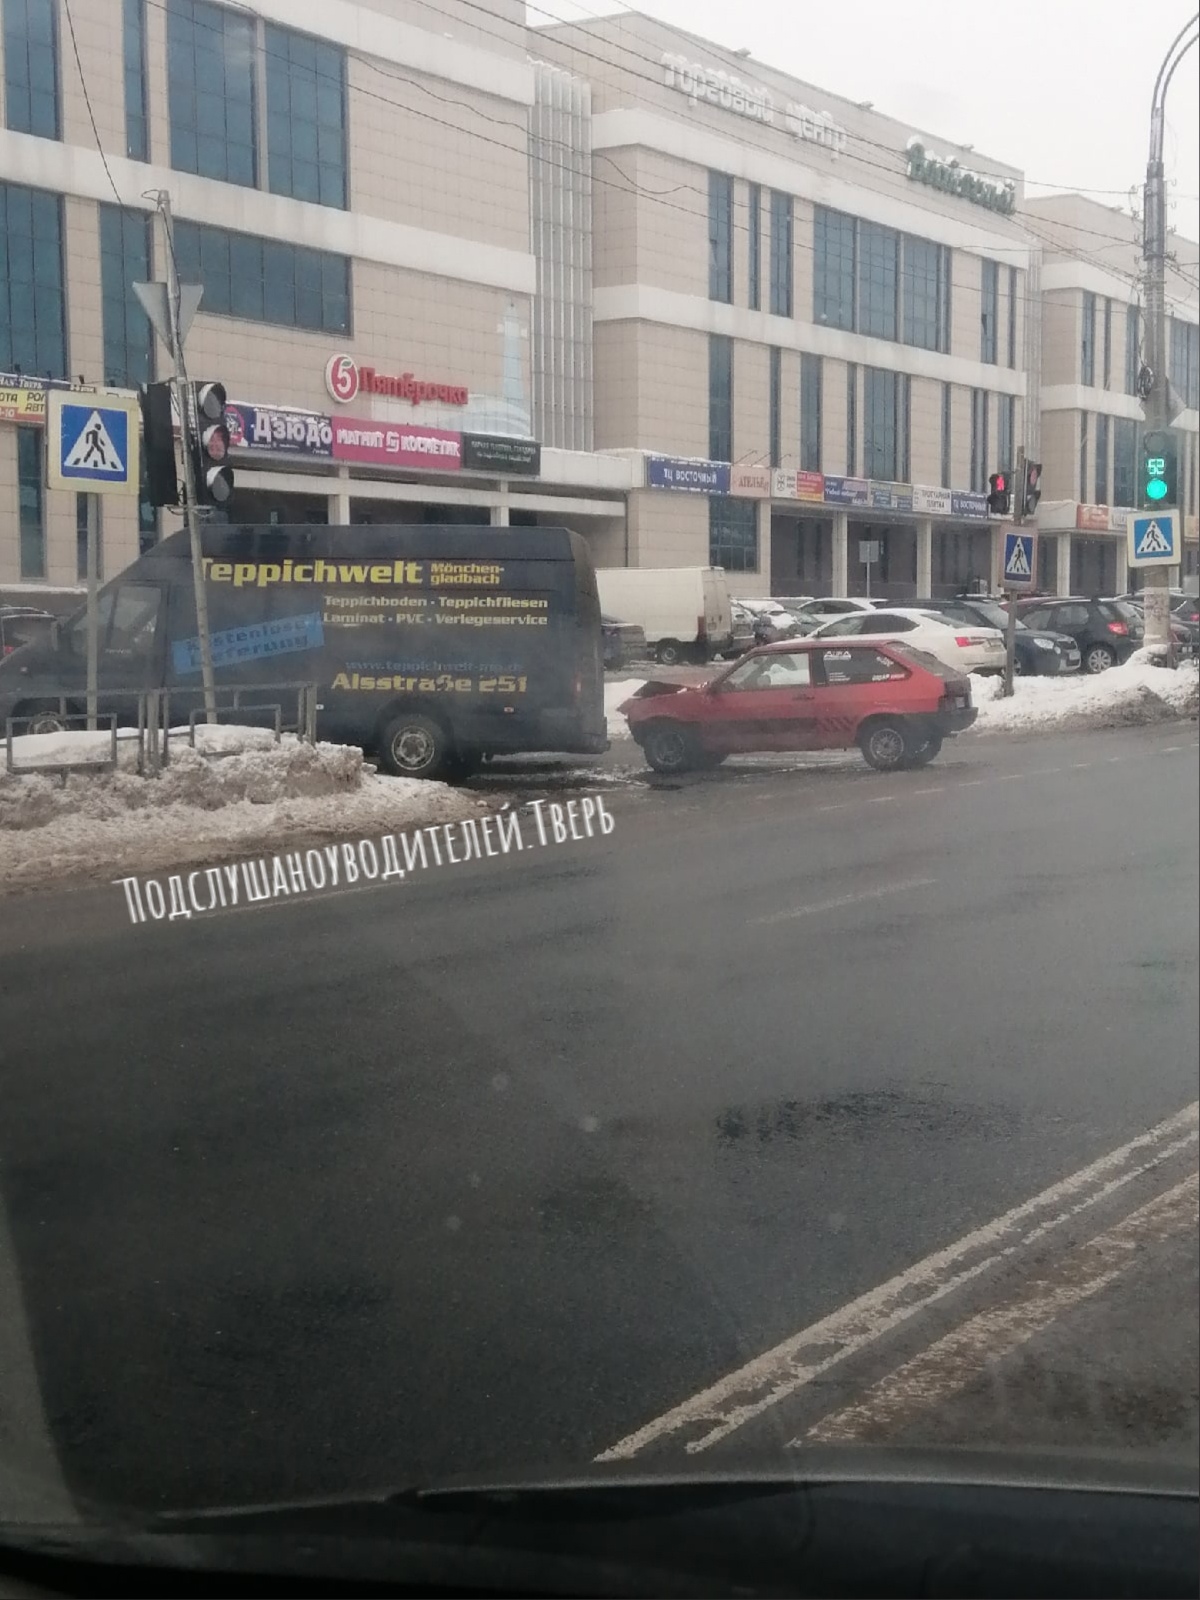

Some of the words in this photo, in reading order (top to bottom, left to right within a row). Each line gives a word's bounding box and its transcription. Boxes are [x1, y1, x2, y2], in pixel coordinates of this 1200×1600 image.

[253, 410, 333, 447] ДЗЮДО
[336, 429, 384, 448] МАГНИТ
[401, 435, 460, 457] КОСМЕТИК
[1147, 458, 1165, 475] 52
[664, 468, 673, 482] ТЦ
[676, 469, 717, 484] ВОСТОЧНЫЙ
[431, 573, 500, 586] gladbach
[324, 596, 427, 609] Teppichboden
[438, 596, 548, 609] Teppichfliesen
[323, 612, 385, 625] Laminat
[396, 613, 424, 625] PVC
[435, 613, 548, 627] Verlegeservice
[479, 675, 527, 693] 251
